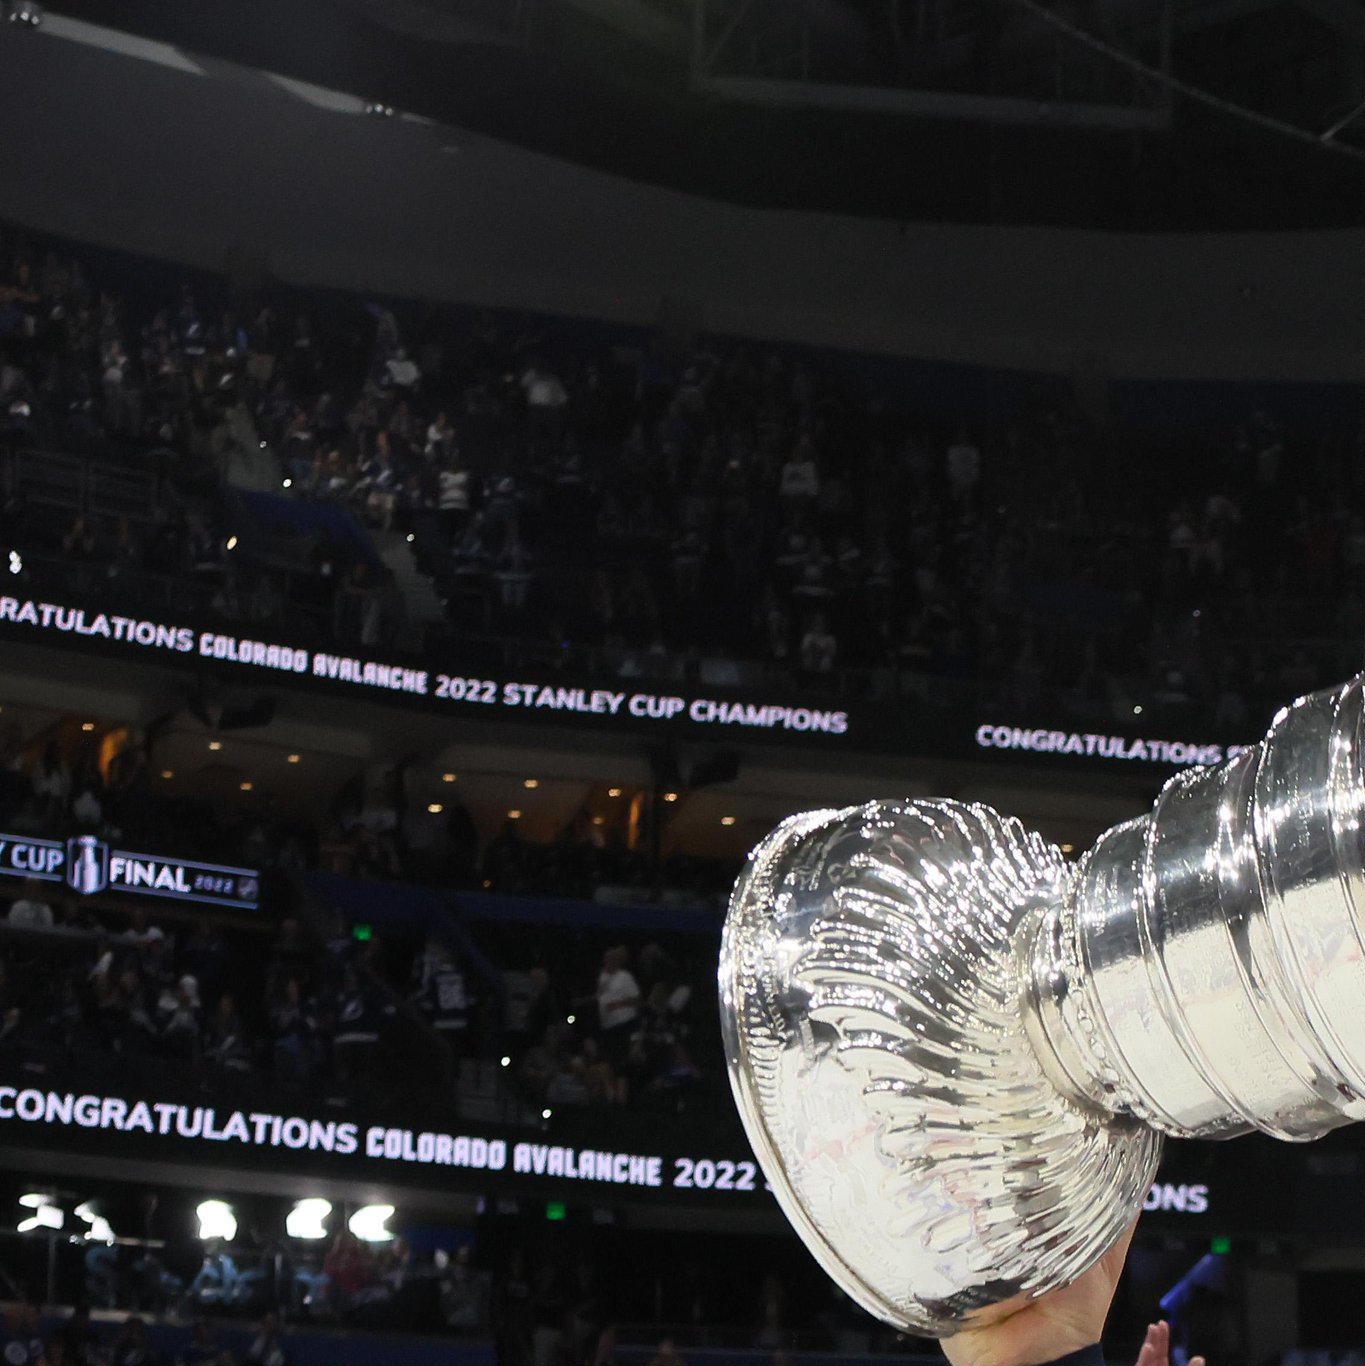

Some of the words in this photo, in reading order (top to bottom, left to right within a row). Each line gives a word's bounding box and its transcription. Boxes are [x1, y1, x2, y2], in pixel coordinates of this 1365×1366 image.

[0, 596, 193, 652] RATULATIONS
[200, 632, 307, 673] COLORADO
[313, 653, 428, 695] AVALANCHE
[435, 674, 496, 704] 2022
[503, 682, 626, 715] STANLEY
[629, 694, 685, 719] CUP
[689, 699, 849, 734] CHAMPIONS
[976, 724, 1223, 765] CONGRATULATIONS
[11, 844, 65, 873] CUP
[109, 857, 191, 893] FINAL
[0, 1086, 359, 1154] CONGRATULATIONS
[366, 1126, 507, 1171] COLORADO
[513, 1143, 663, 1187] AVALANCHE
[673, 1157, 756, 1191] 2022
